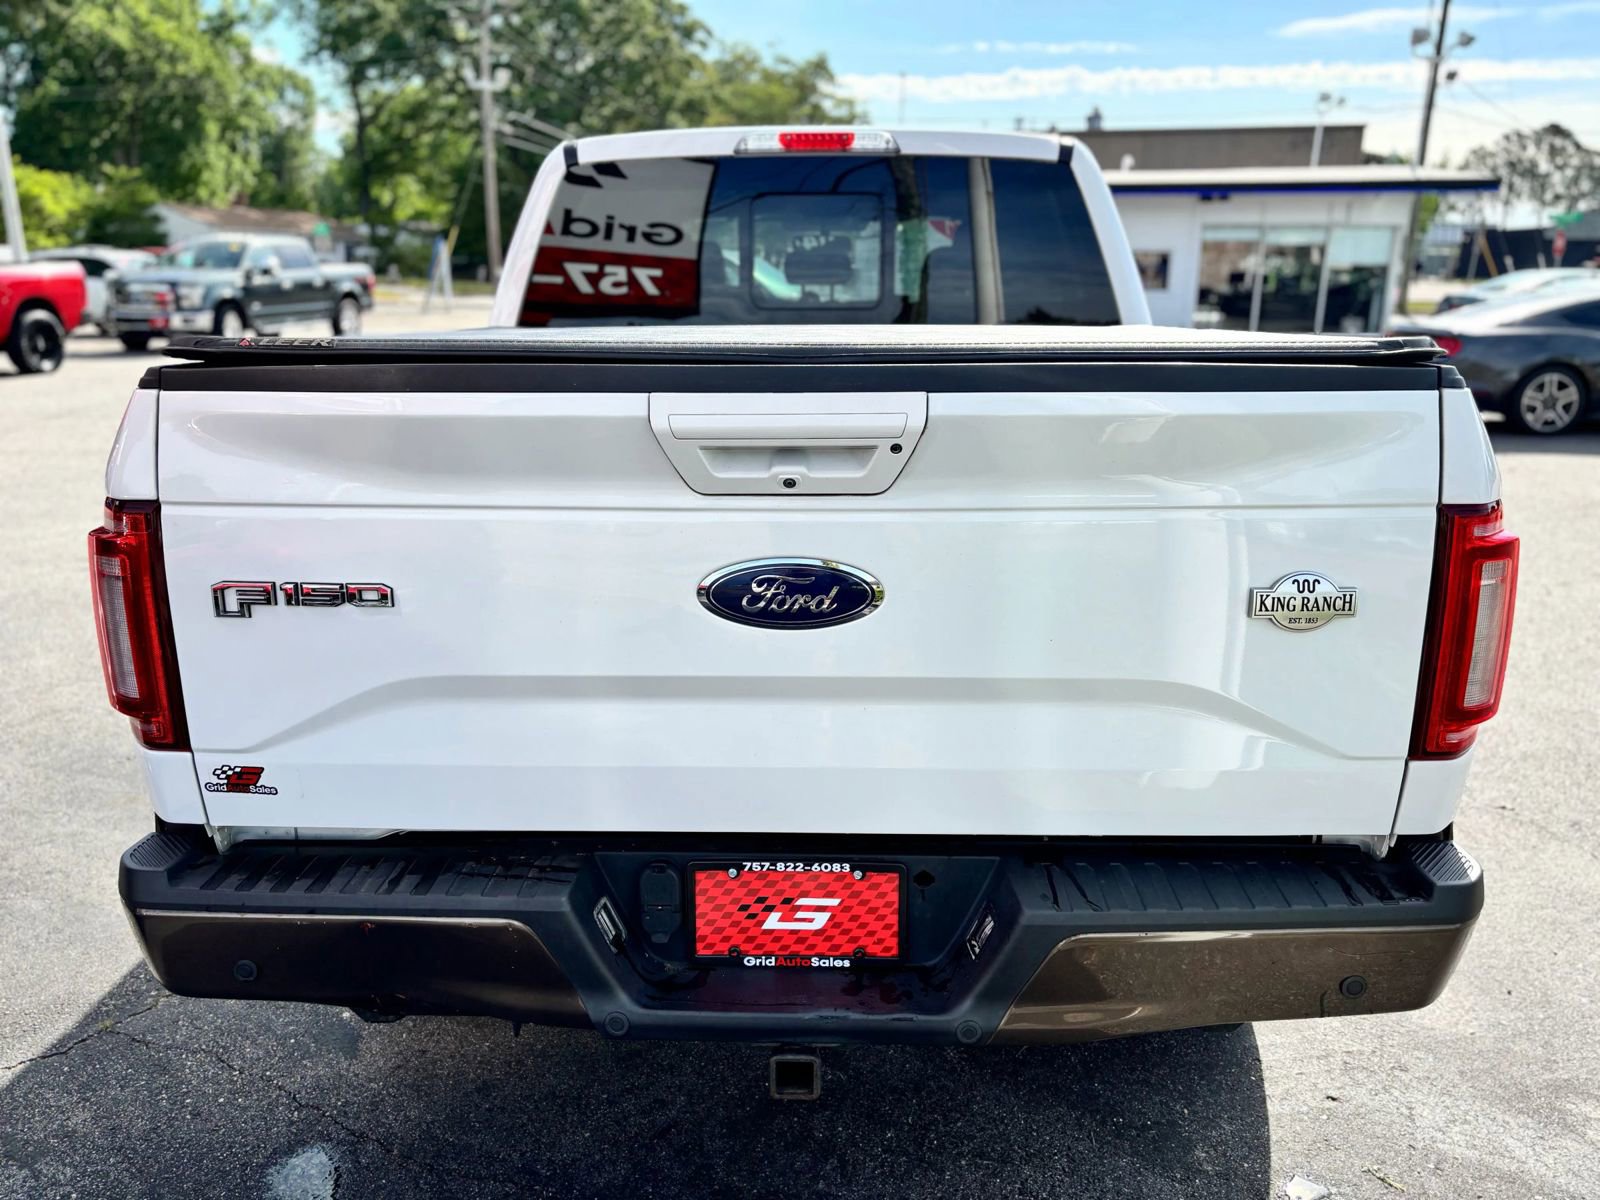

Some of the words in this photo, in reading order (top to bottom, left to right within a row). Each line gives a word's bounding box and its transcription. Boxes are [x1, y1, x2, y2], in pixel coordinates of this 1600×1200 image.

[741, 574, 840, 614] Ford
[1258, 594, 1297, 612] KING
[1300, 593, 1354, 612] RANCH
[742, 862, 851, 872] 757-822-6083
[743, 956, 851, 968] GridAutoSales
